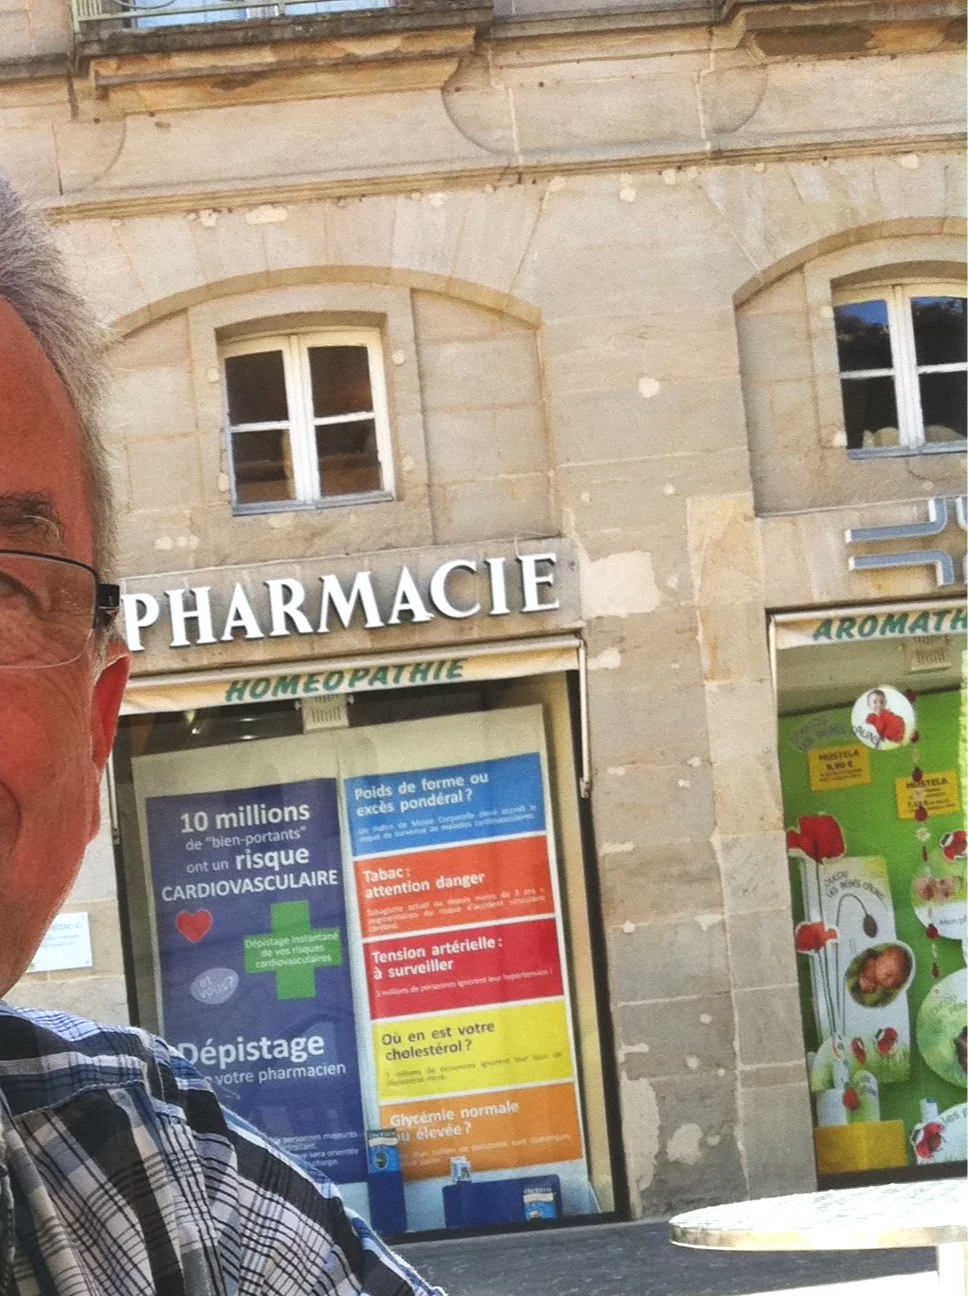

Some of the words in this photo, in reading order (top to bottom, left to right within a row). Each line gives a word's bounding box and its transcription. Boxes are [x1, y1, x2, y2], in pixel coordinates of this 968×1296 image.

[121, 551, 561, 652] PHARMACIE
[224, 658, 465, 703] HOMEOPATHIE
[355, 783, 392, 800] Poids
[398, 781, 416, 795] de
[422, 776, 465, 791] forme
[470, 773, 489, 785] ou
[180, 811, 209, 833] 10
[215, 803, 311, 830] millions
[356, 799, 394, 817] excès
[185, 838, 202, 851] de
[186, 861, 209, 874] ont
[212, 859, 229, 872] un
[235, 847, 310, 871] risque
[161, 869, 338, 902] CARDIOVASCULAIRE
[364, 879, 430, 900] attention
[435, 873, 486, 891] danger
[372, 946, 426, 965] Tension
[373, 966, 383, 980] à
[387, 958, 454, 979] surveiller
[382, 1030, 402, 1046] Où
[407, 1031, 425, 1043] en
[431, 1027, 452, 1039] est
[457, 1021, 495, 1036] votre
[177, 1034, 325, 1070] Dépistage
[215, 1071, 254, 1086] votre
[258, 1061, 347, 1085] pharmacien
[389, 1107, 456, 1128] Glycémie
[461, 1100, 520, 1119] normale
